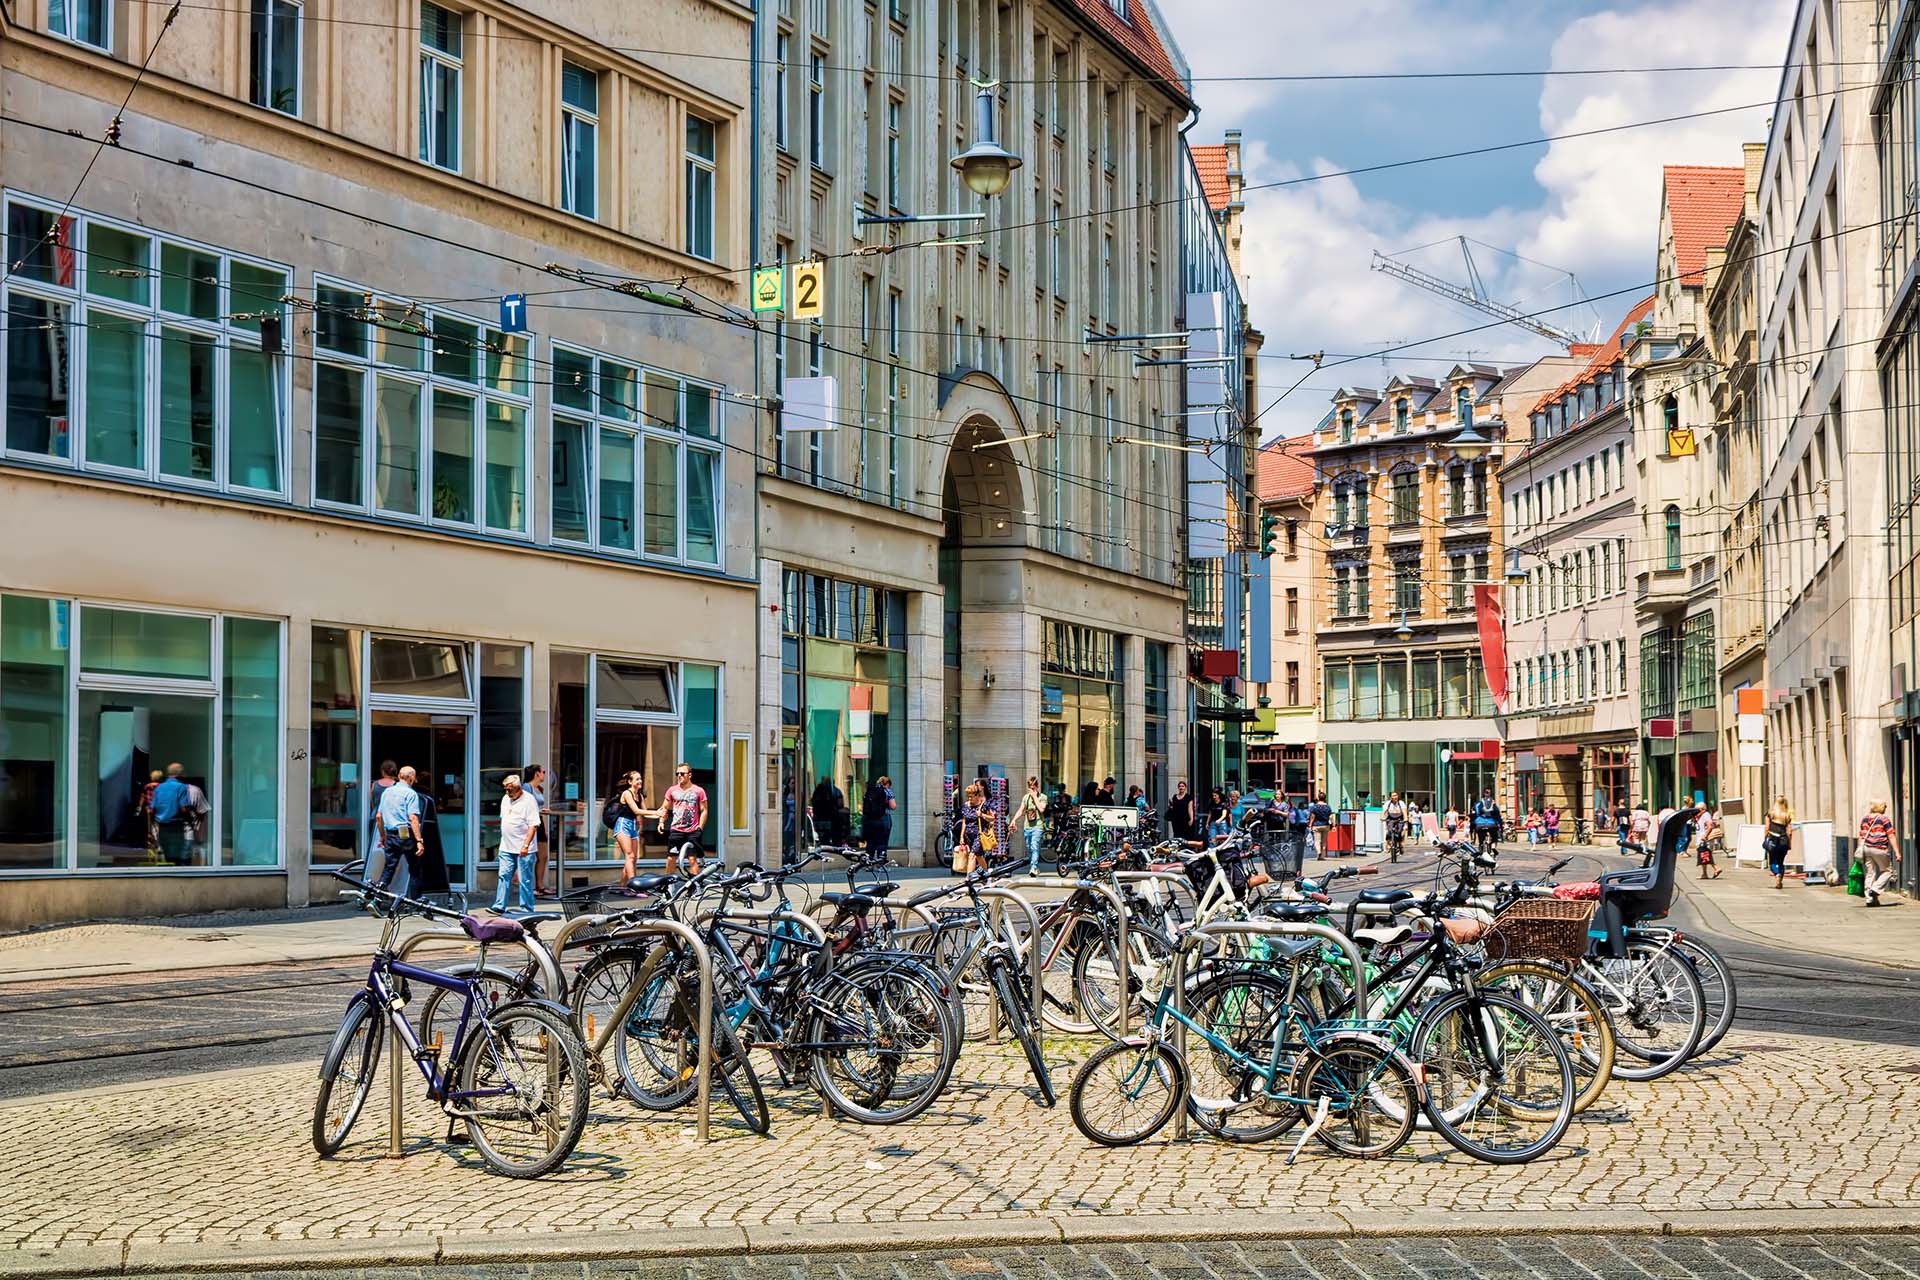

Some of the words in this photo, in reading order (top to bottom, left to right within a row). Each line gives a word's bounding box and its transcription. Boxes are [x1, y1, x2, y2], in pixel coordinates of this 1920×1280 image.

[798, 274, 817, 308] 2
[505, 300, 521, 326] T
[769, 729, 777, 746] 2
